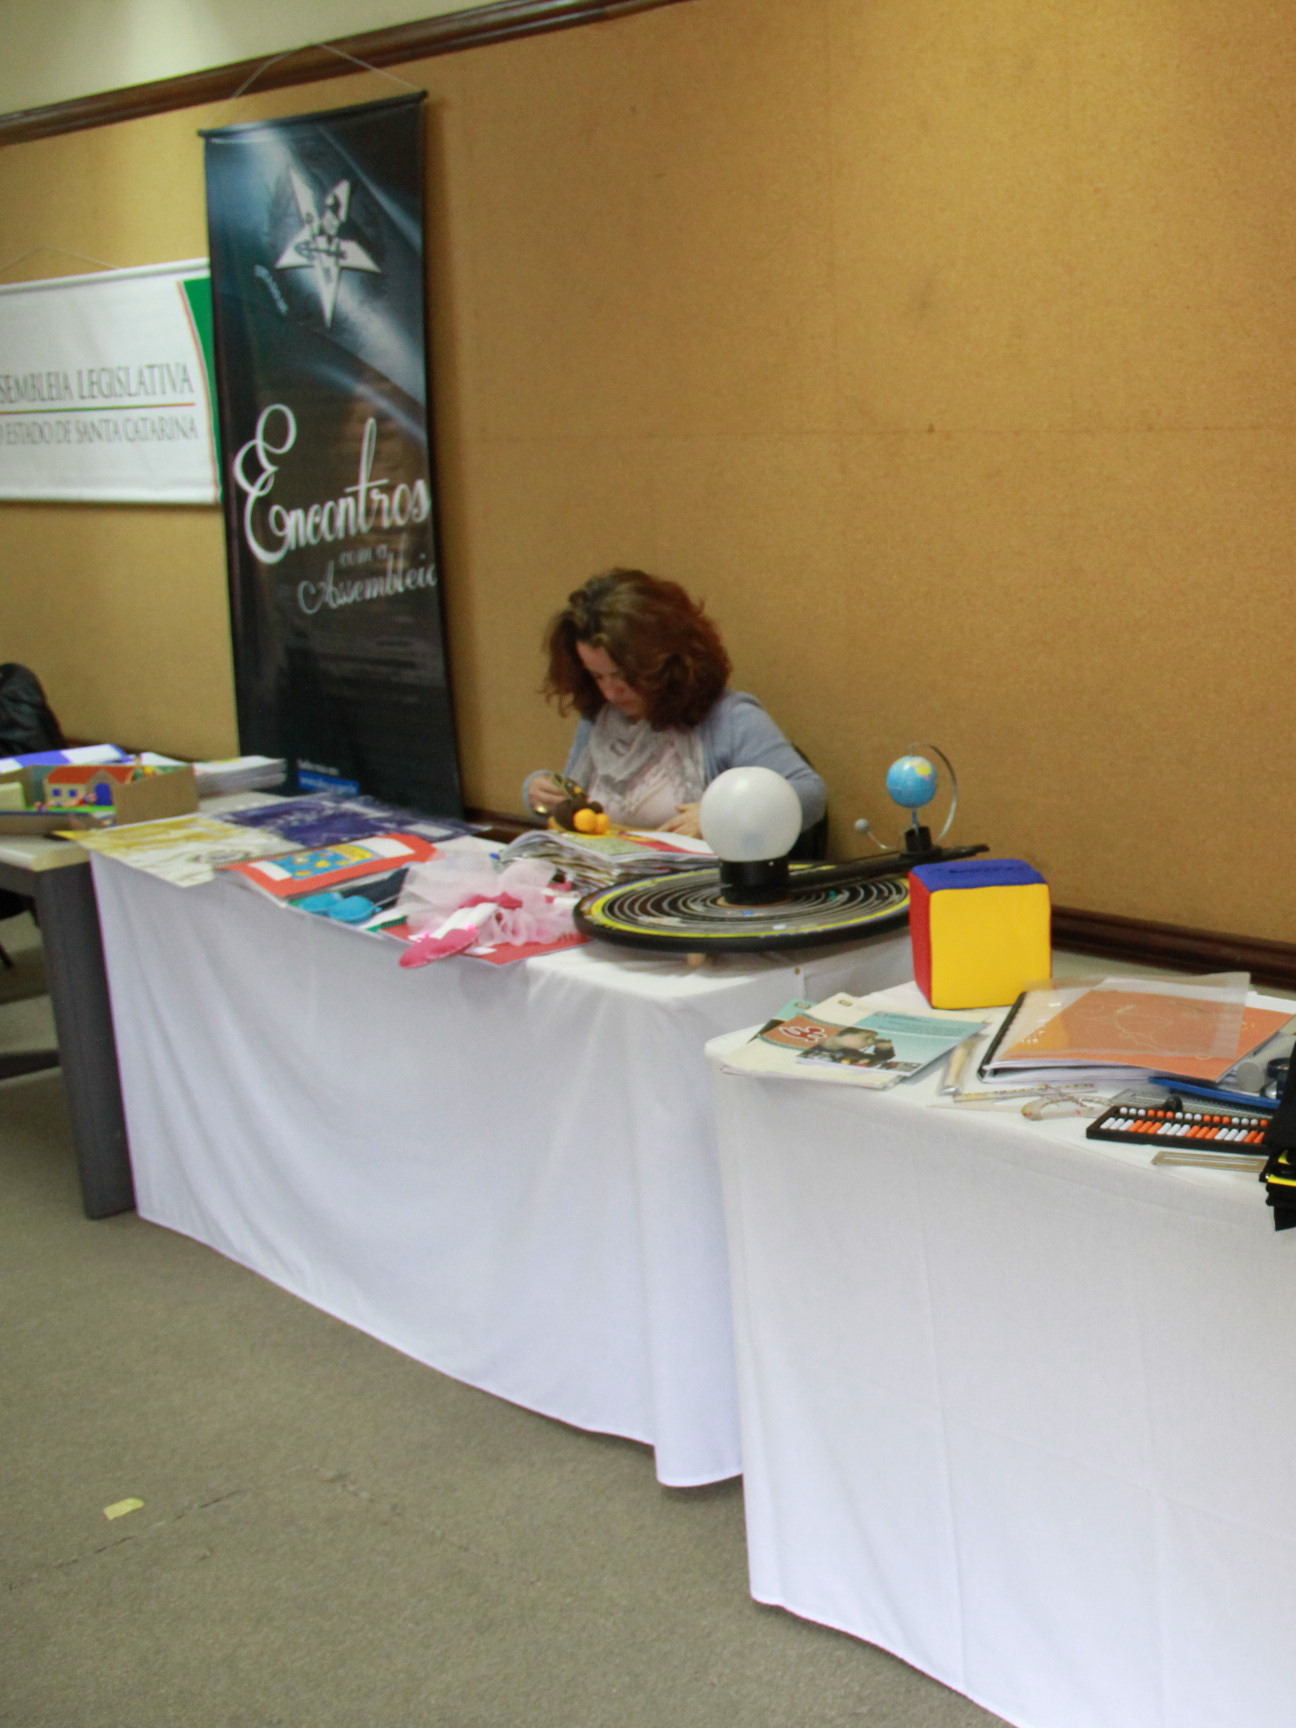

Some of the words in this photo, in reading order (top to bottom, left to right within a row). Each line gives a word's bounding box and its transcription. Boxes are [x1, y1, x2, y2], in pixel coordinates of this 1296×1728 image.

[77, 363, 195, 400] LEGISLATIVA
[74, 418, 121, 443] SANTA
[122, 416, 199, 441] CATARINA
[233, 403, 431, 564] Encontros
